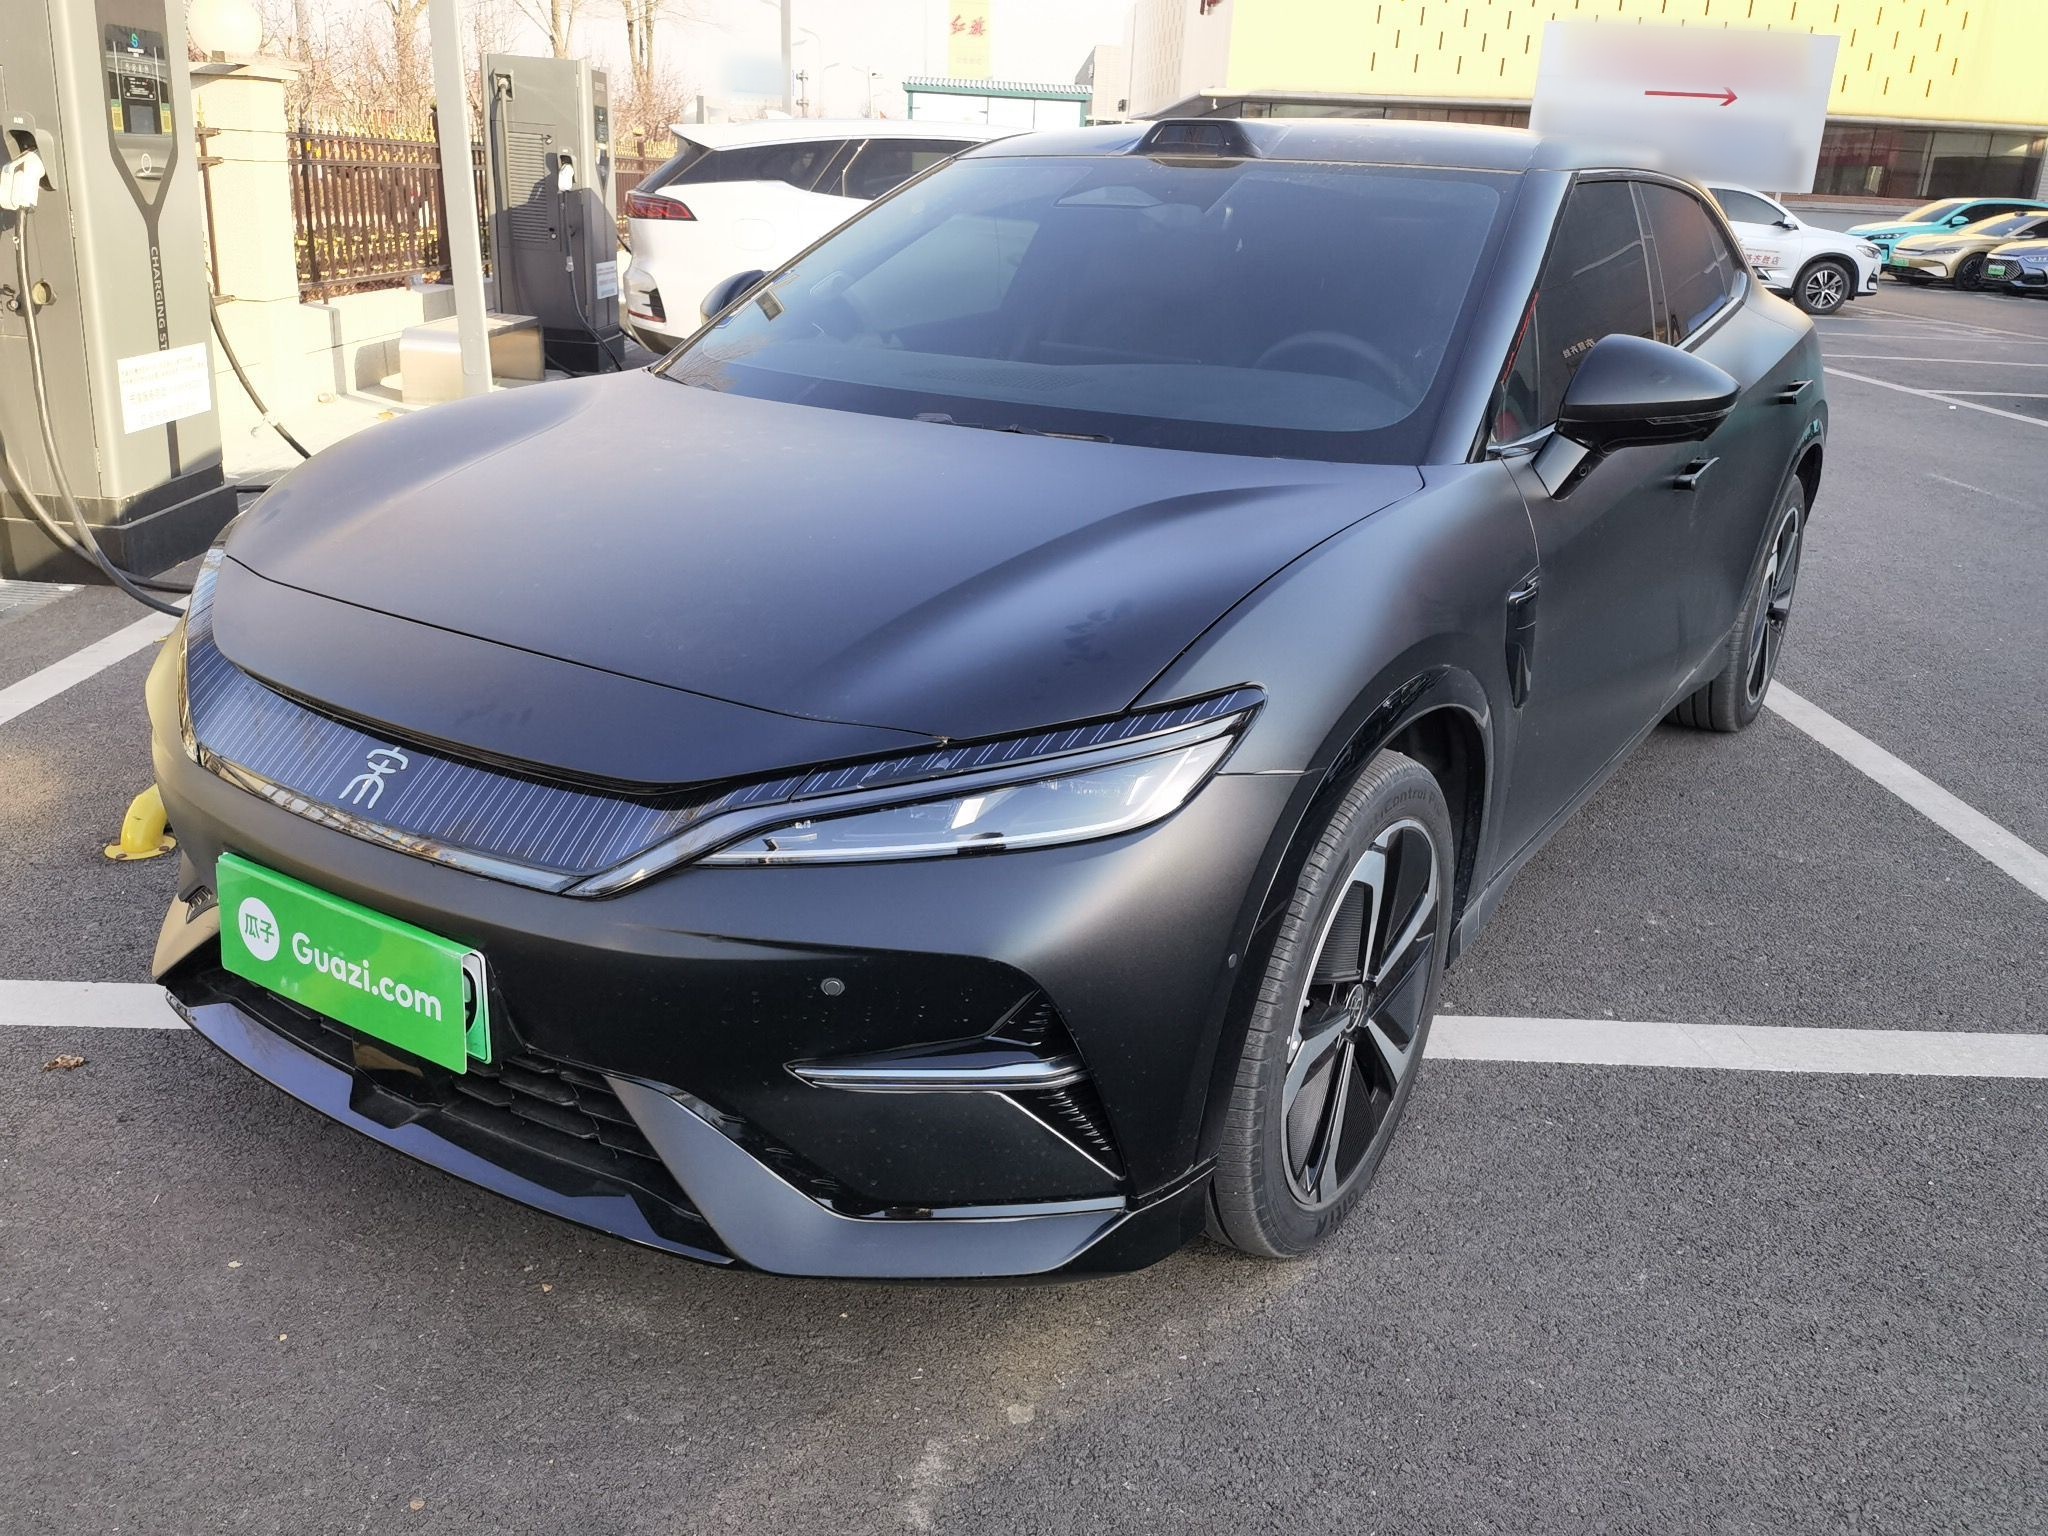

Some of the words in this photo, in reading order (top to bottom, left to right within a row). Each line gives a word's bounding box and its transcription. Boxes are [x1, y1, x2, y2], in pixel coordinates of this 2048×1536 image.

[950, 14, 986, 36] 红旗
[151, 246, 166, 329] CHARGING
[244, 913, 275, 944] 瓜子
[291, 932, 442, 1022] Guazi.com
